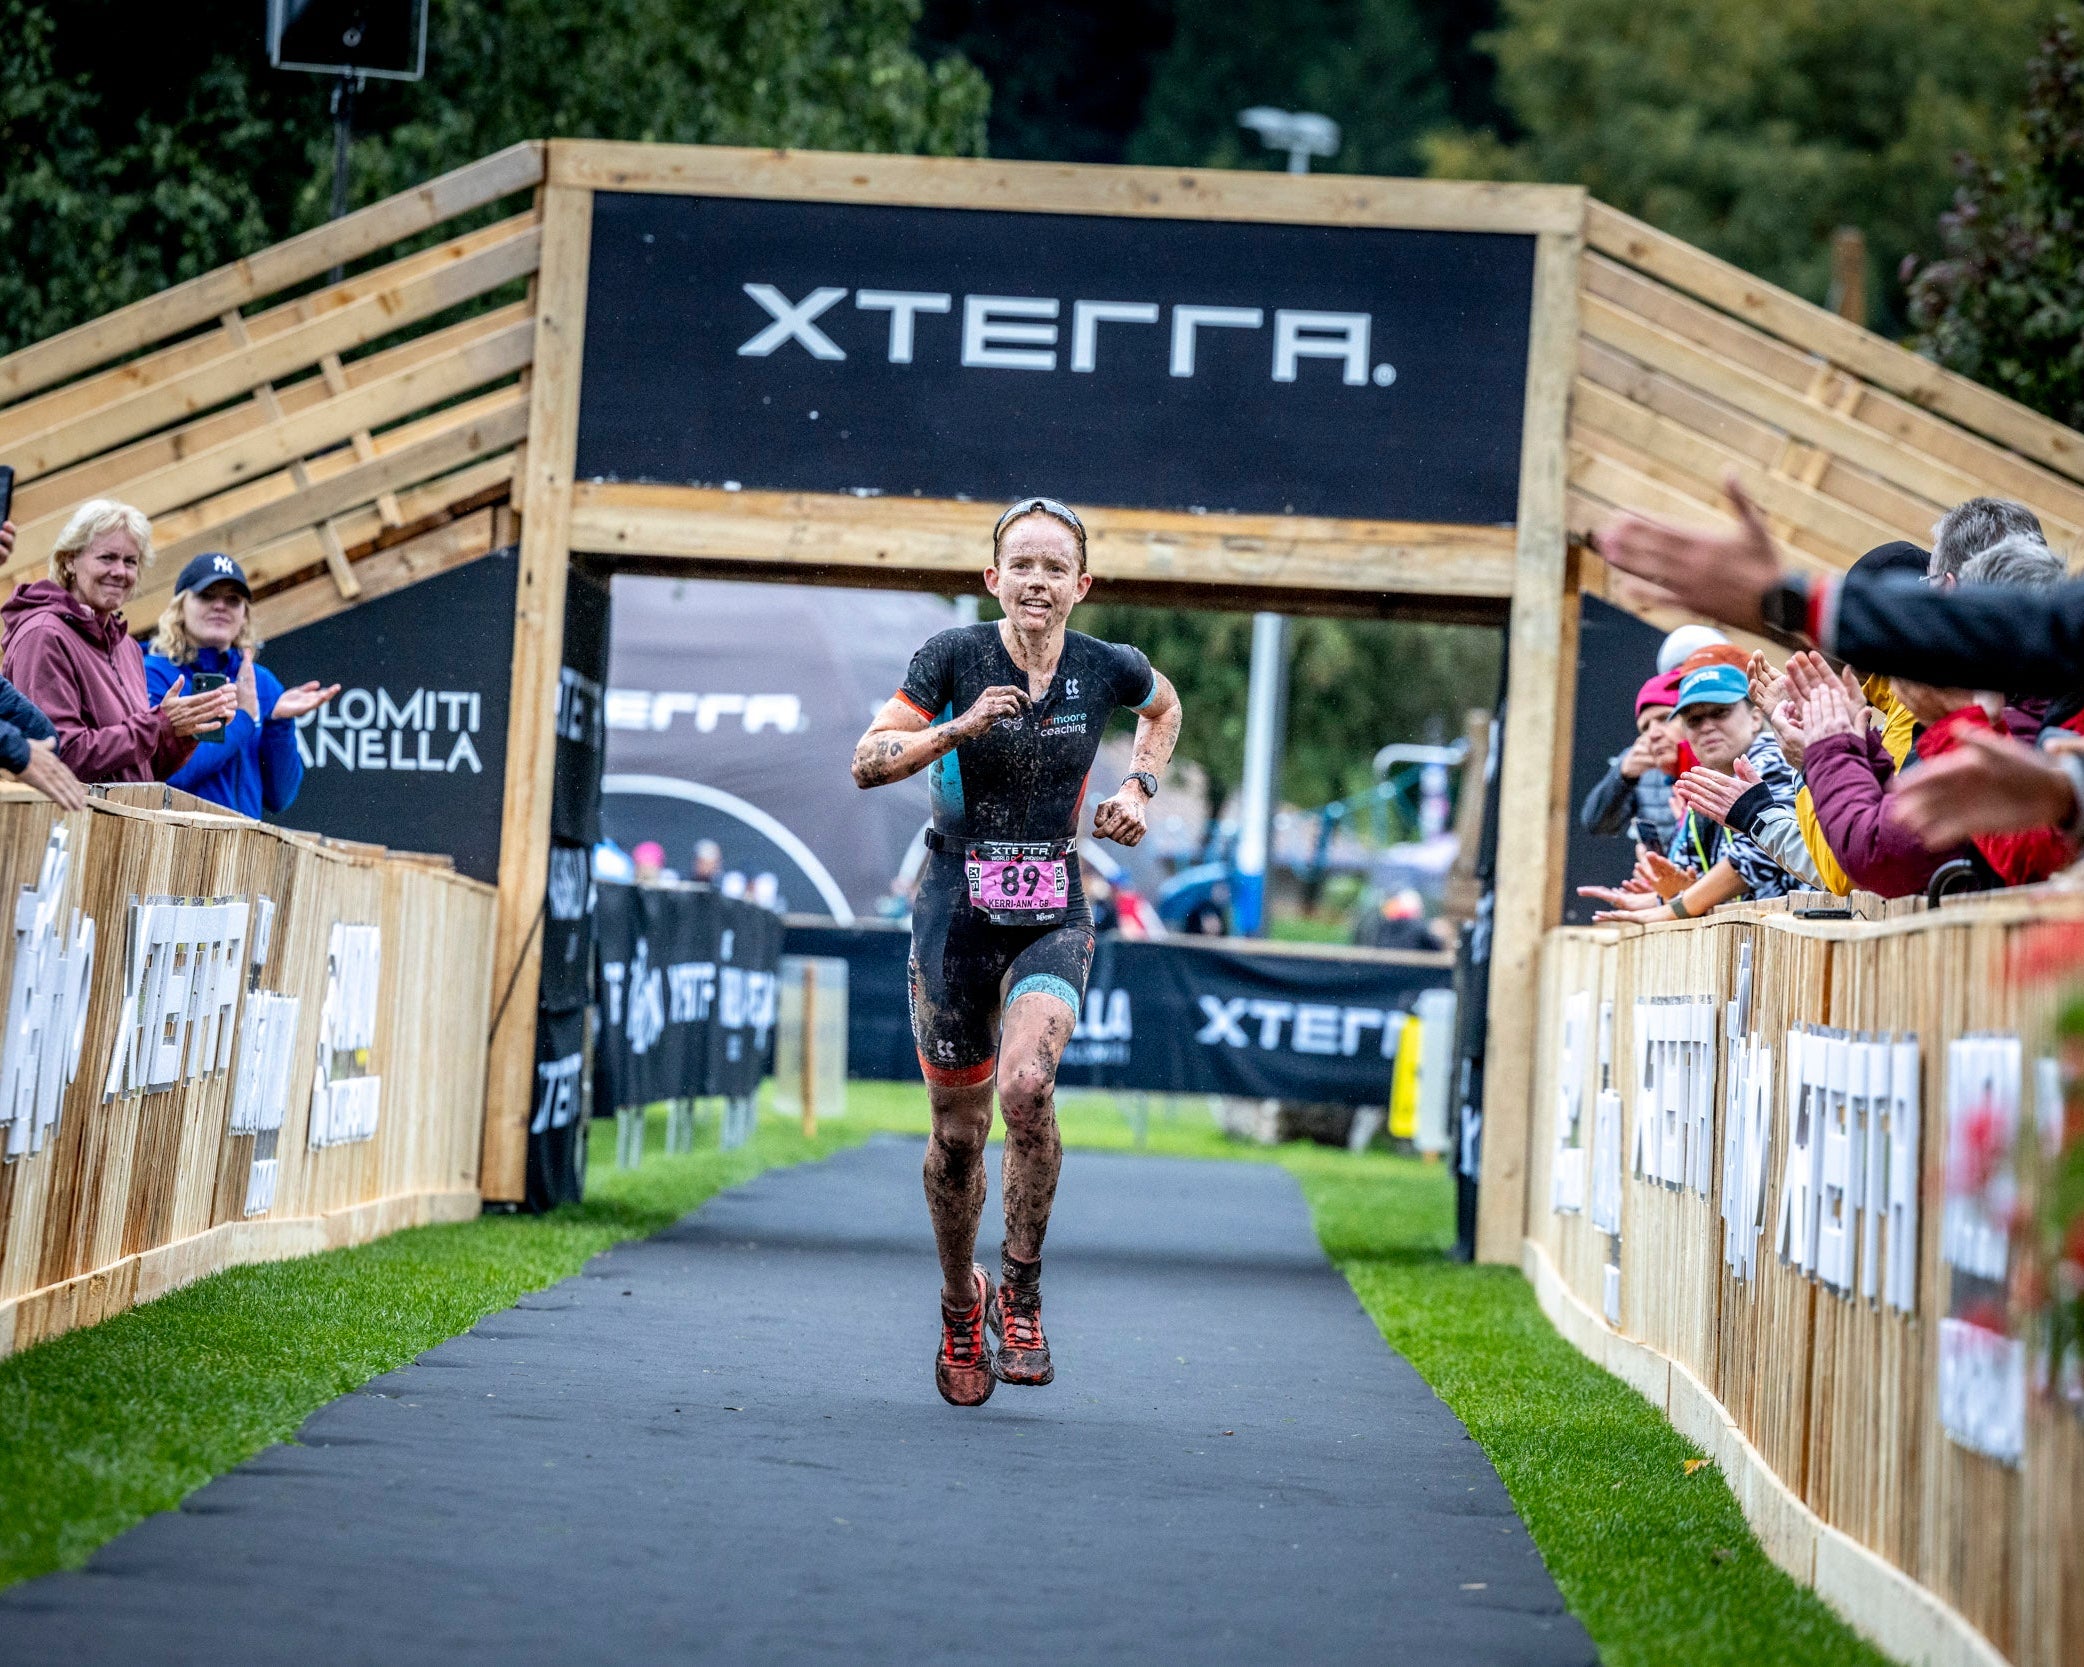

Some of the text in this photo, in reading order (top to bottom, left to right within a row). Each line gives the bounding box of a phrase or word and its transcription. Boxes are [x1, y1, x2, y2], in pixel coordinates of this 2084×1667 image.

[737, 283, 1373, 386] XTERRA
[293, 687, 482, 734] LOMITI
[1040, 722, 1087, 737] coaching
[1001, 866, 1041, 897] 89
[989, 899, 1033, 908] KERRI-ANN
[1197, 995, 1403, 1059] XTERR
